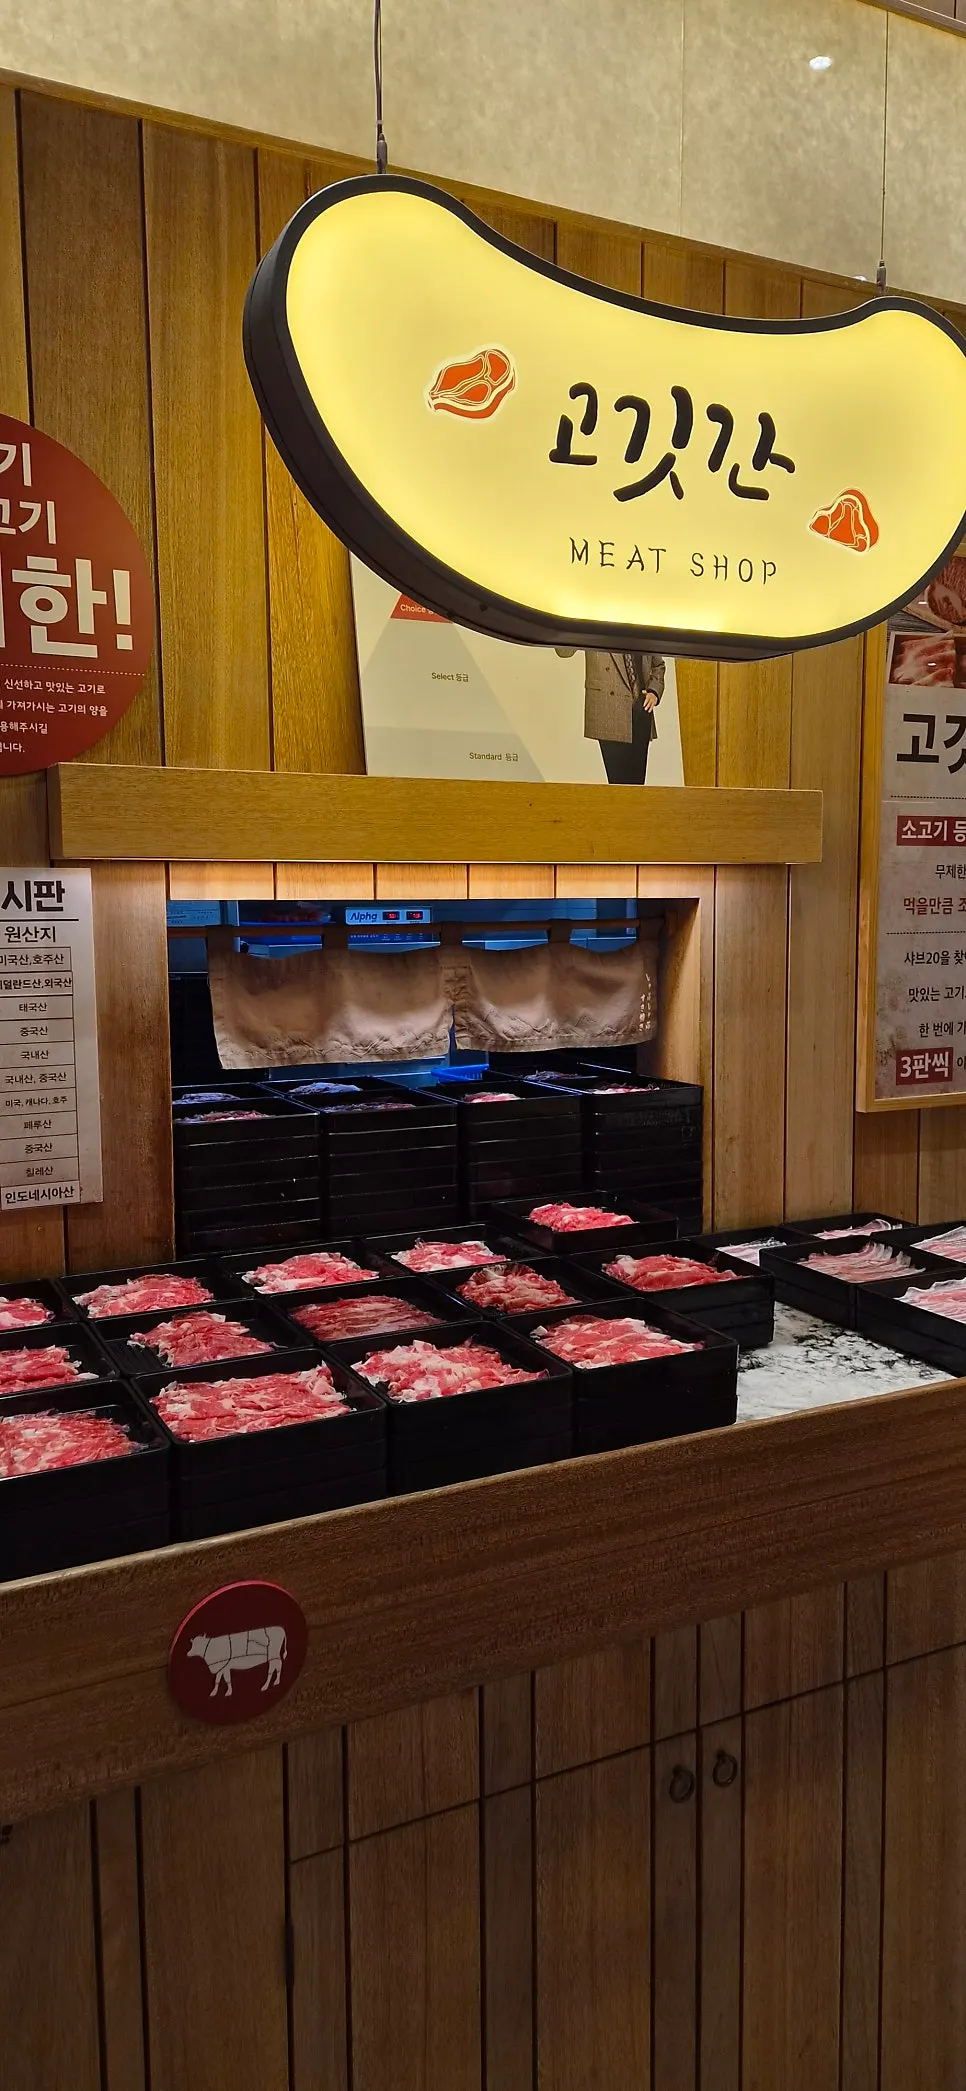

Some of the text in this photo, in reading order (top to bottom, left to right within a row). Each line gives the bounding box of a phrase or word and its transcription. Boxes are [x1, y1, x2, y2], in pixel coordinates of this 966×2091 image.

[549, 382, 795, 502] 고깃간
[569, 537, 777, 585] MEAT SHOP
[0, 553, 133, 658] 한!
[400, 604, 426, 613] Choice
[431, 672, 469, 682] Select 등급
[4, 679, 106, 694] 신선하고 맛있는 고기로
[6, 701, 56, 713] 가져가시는
[58, 703, 86, 714] 고기의
[89, 705, 108, 717] 양을
[469, 752, 519, 762] Standard 등급
[901, 820, 947, 841] 소고기
[935, 864, 966, 879] 무제한
[1, 880, 65, 912] 시판
[903, 897, 954, 915] 먹을만큼
[350, 912, 378, 923] Alpha
[4, 926, 56, 943] 원산지
[904, 950, 950, 966] 샤브20을
[0, 978, 72, 990] 덜란드산,외국산
[908, 987, 940, 1002] 맛있는
[19, 1002, 48, 1012] 태국산
[20, 1026, 49, 1037] 중국산
[919, 1023, 929, 1037] 한
[933, 1021, 954, 1036] 번에
[21, 1050, 49, 1060] 국내산
[900, 1051, 949, 1078] 3판씩
[5, 1072, 67, 1084] 국내산, 중국산
[24, 1119, 52, 1129] 페루산
[25, 1143, 53, 1154] 중국산
[25, 1166, 54, 1178] 칠레산
[5, 1186, 75, 1204] 인도네시아산
